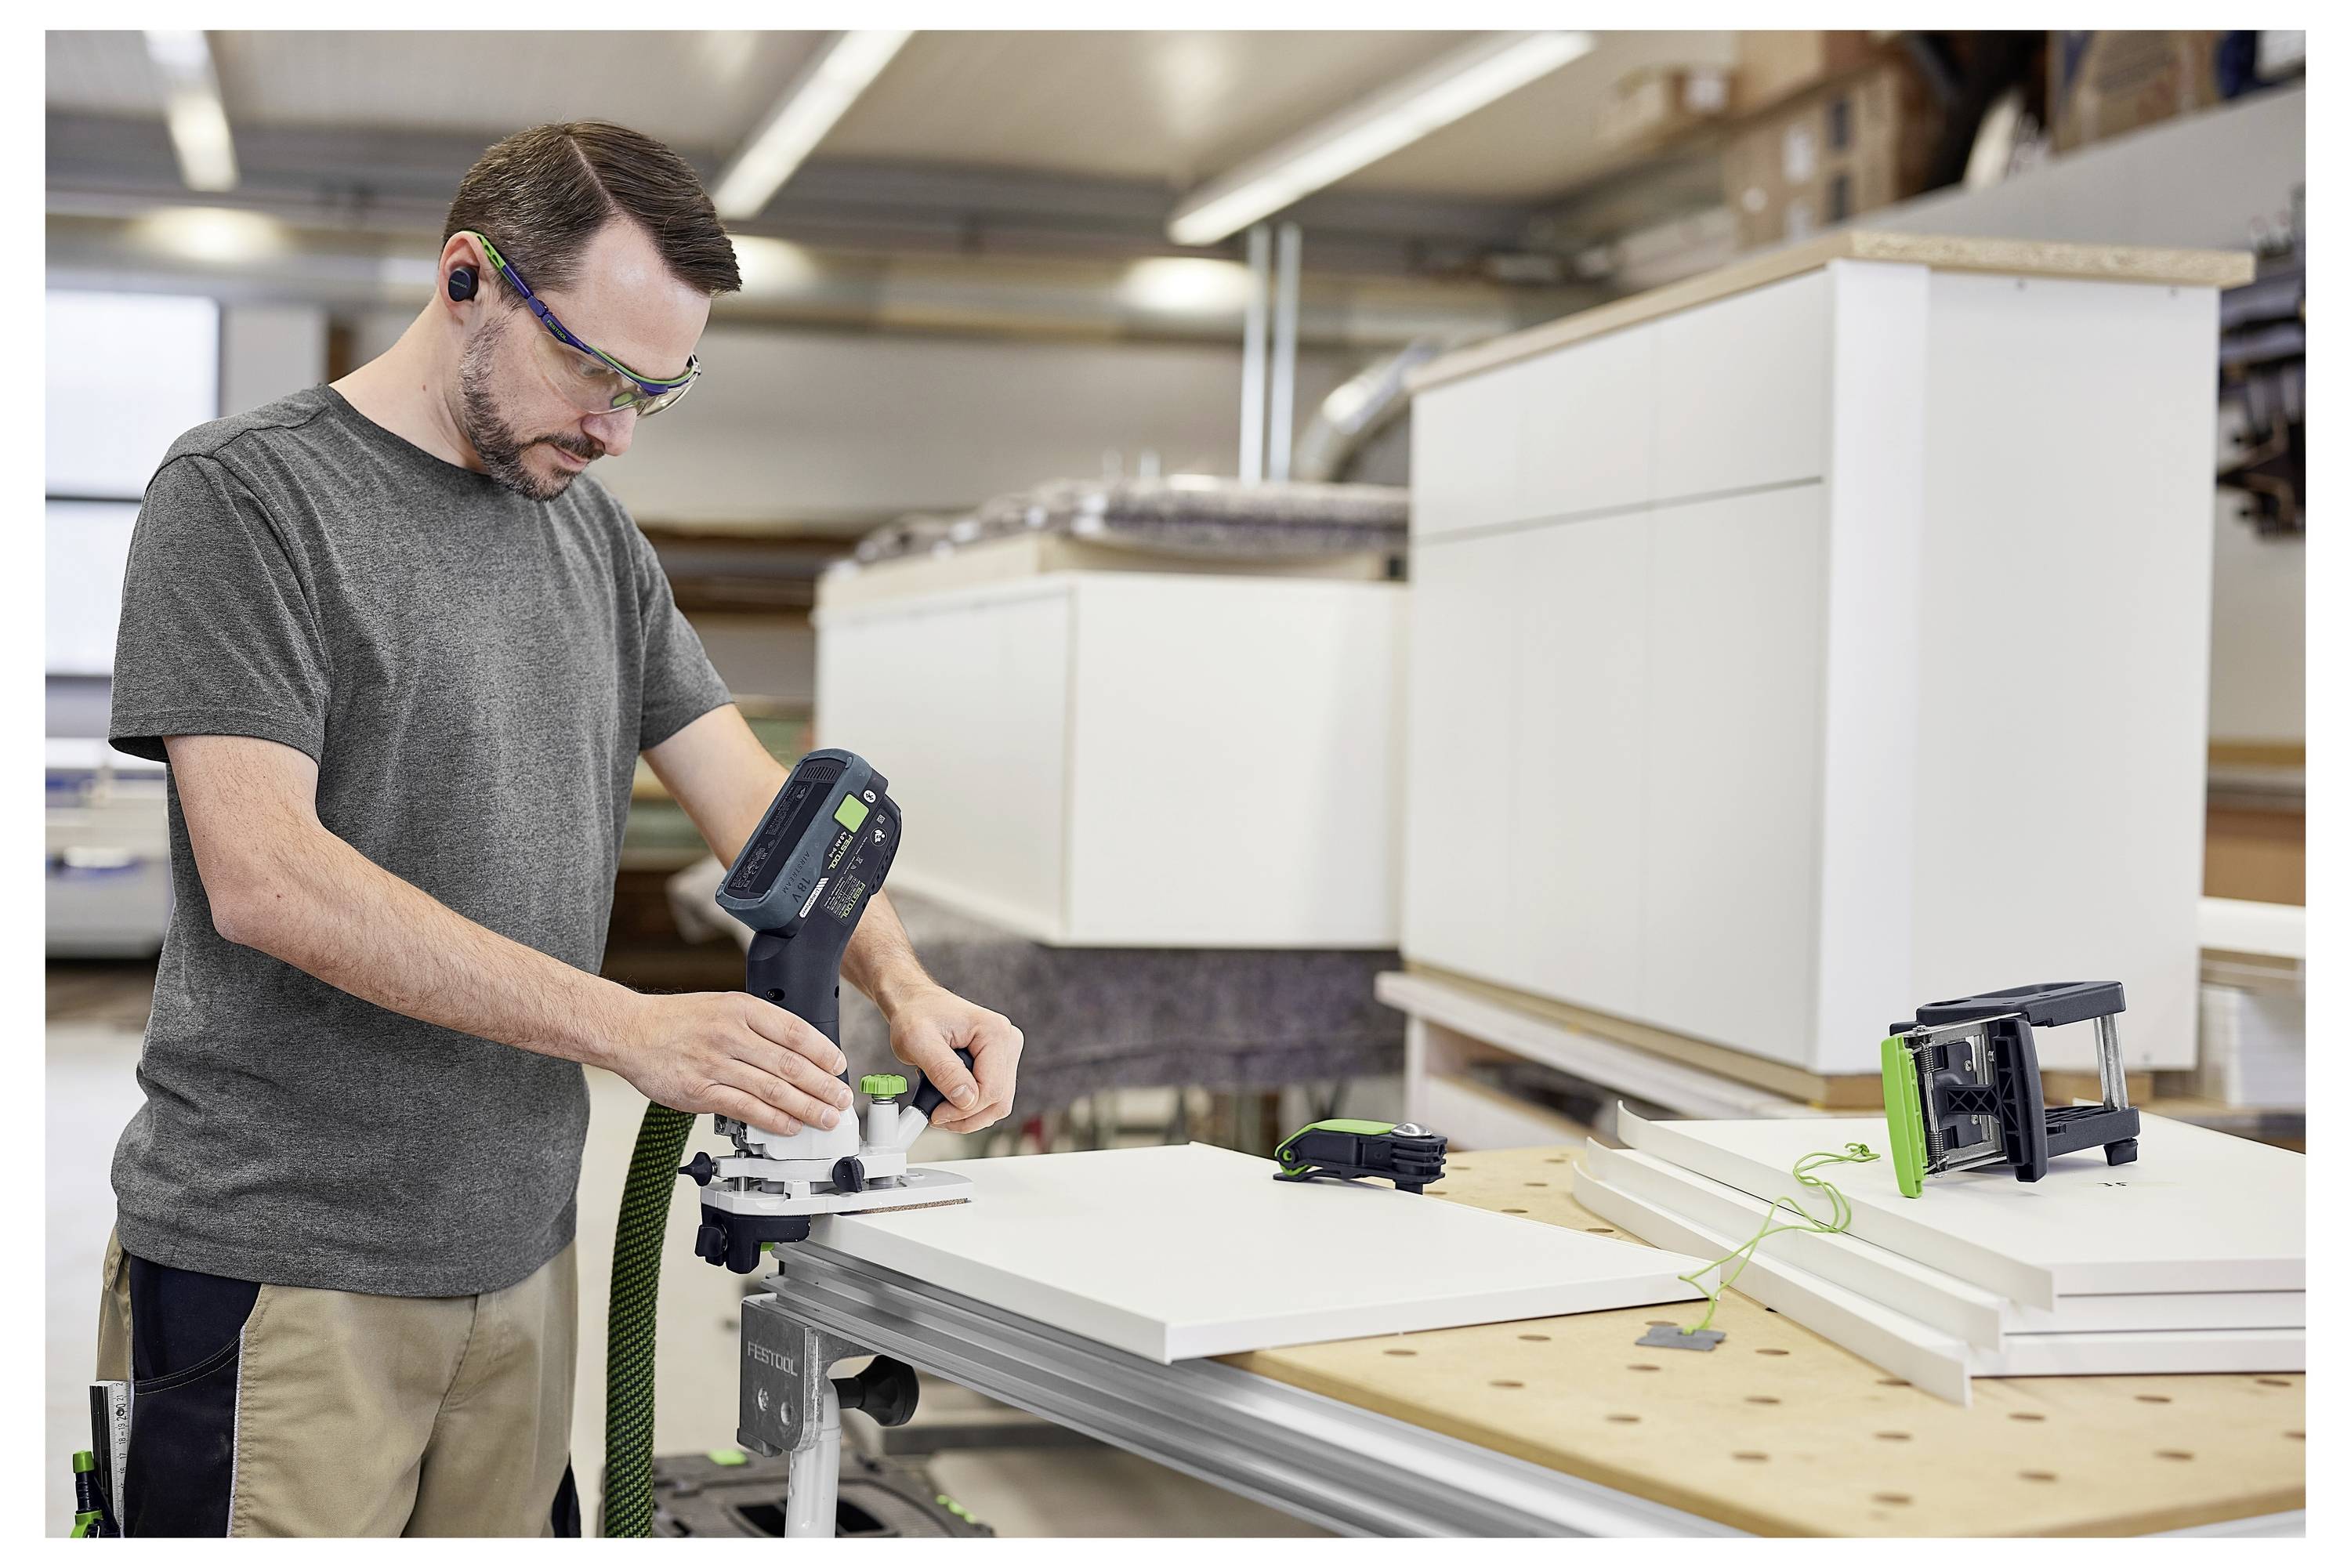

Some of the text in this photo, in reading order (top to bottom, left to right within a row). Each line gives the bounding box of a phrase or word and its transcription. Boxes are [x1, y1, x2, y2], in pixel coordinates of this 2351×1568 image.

[546, 318, 568, 342] FESTOOL
[828, 835, 853, 870] FESTOOL
[835, 838, 842, 847] Ah
[782, 850, 810, 894] AIRSTREAM
[792, 878, 811, 904] 18 V
[840, 882, 866, 919] FESTOOL
[747, 1341, 798, 1377] FESTOOL
